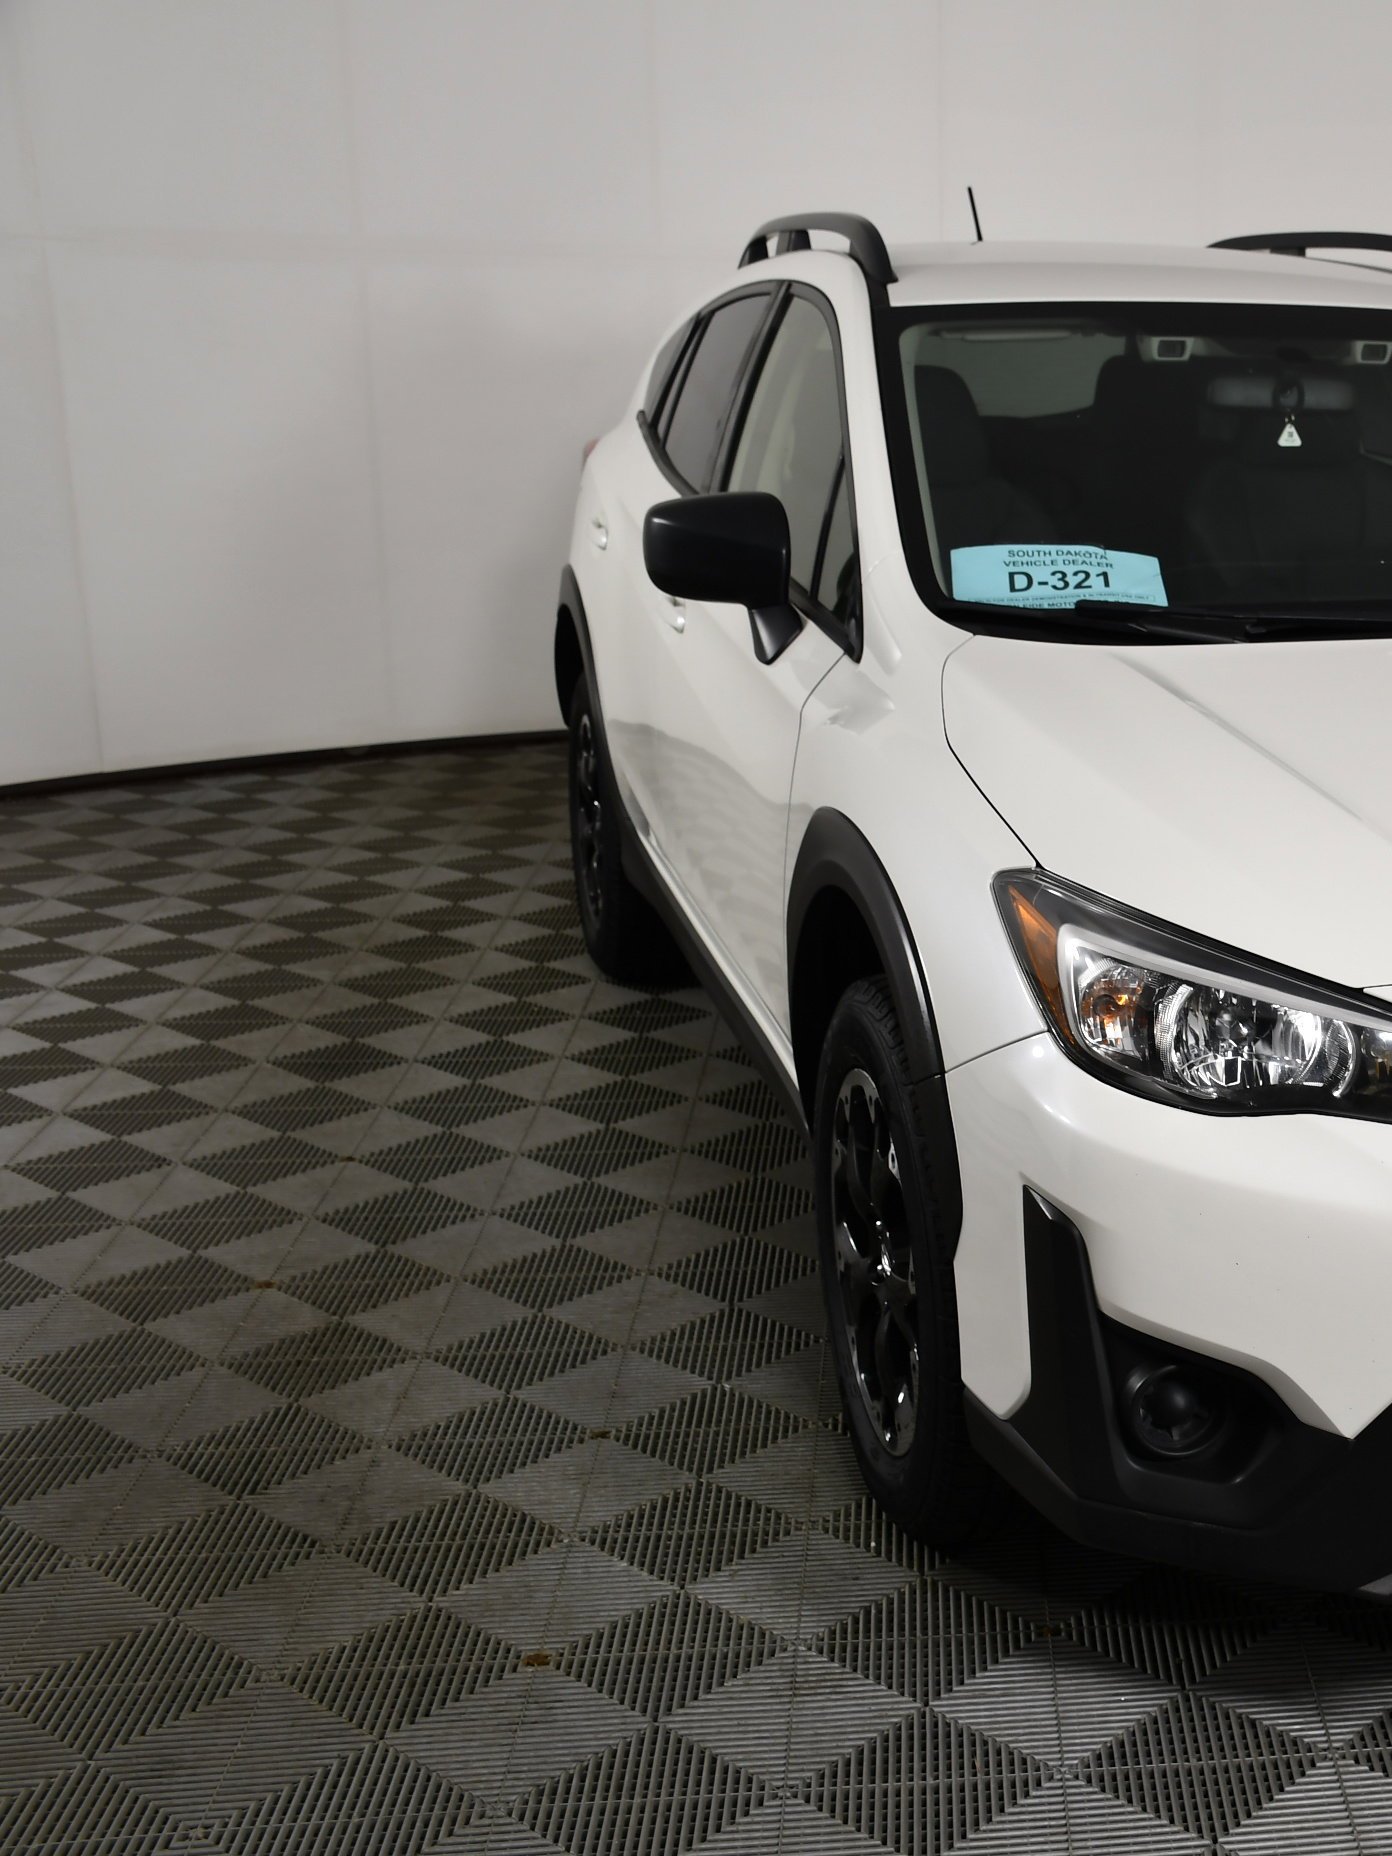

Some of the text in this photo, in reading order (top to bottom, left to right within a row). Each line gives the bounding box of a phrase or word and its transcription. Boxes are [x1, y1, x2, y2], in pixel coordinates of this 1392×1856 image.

[1007, 549, 1109, 560] SOUTH DAKOTA
[1003, 558, 1114, 569] VEHICLE DEALER
[1008, 570, 1110, 593] D-321
